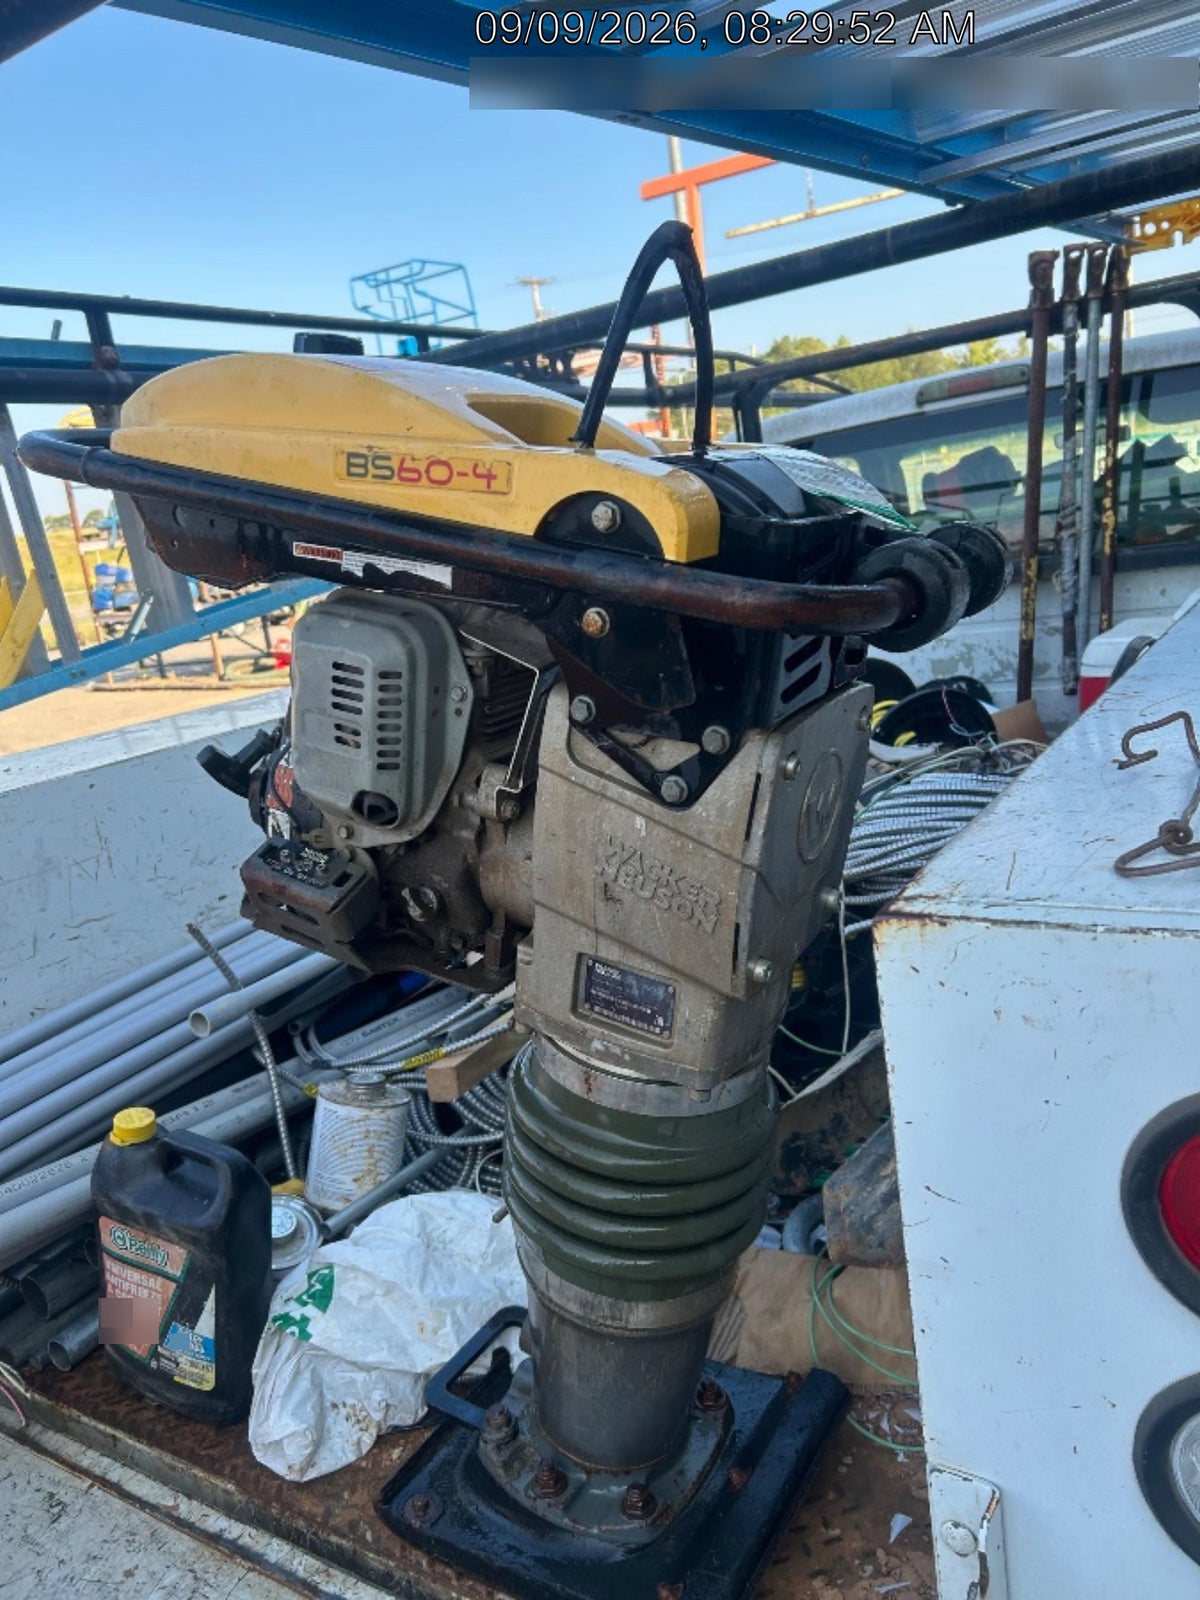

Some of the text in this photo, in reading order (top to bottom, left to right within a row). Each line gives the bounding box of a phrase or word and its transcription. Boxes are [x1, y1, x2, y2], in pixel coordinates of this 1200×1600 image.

[346, 451, 498, 490] BS60-4
[597, 856, 721, 935] NEUSON
[601, 834, 724, 906] WACKER
[106, 1261, 163, 1292] UNIVERSAL
